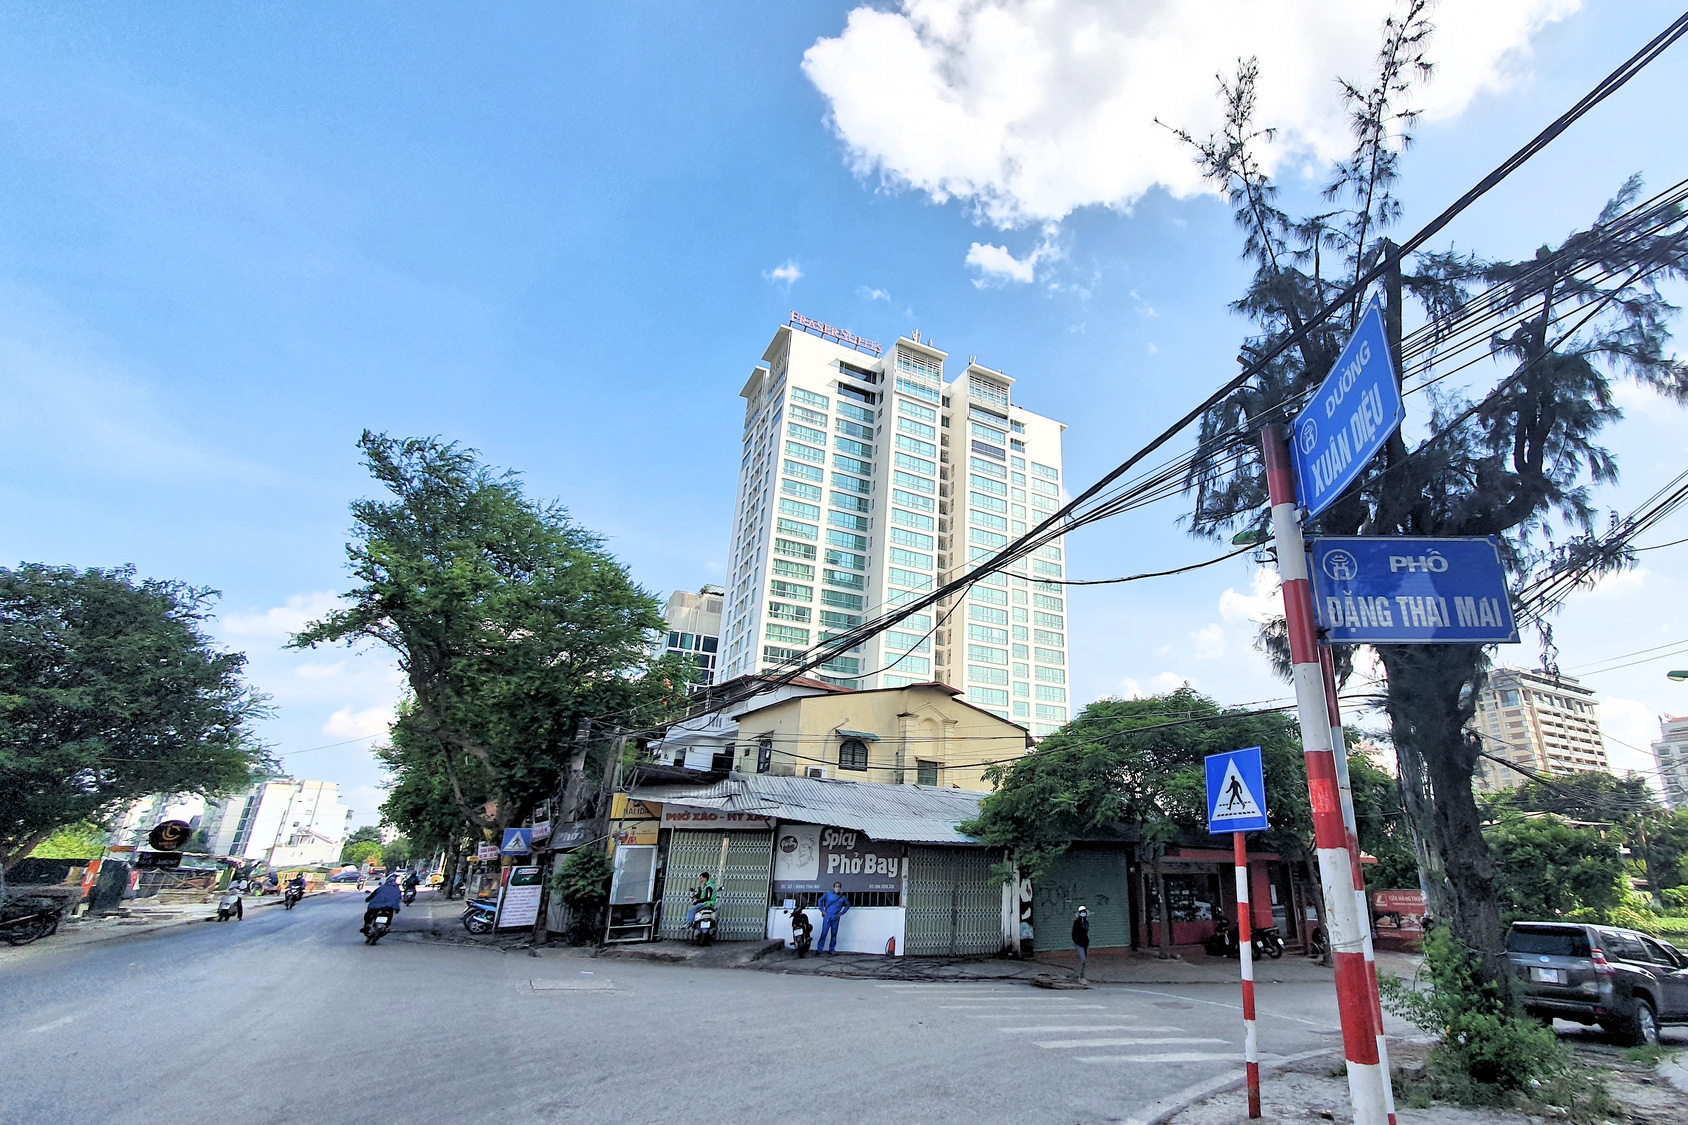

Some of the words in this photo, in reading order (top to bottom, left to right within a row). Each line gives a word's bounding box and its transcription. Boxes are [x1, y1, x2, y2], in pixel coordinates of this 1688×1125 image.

[790, 310, 840, 337] FRASER
[1325, 340, 1370, 419] ĐƯỜNG
[1311, 426, 1352, 497] XUÂN
[1350, 382, 1384, 453] DIỆU
[1389, 548, 1449, 573] PHỐ
[1326, 589, 1393, 633] ĐẶNG
[1395, 596, 1451, 628] THAI
[1453, 596, 1503, 627] MAI
[666, 811, 691, 821] PHỞ
[692, 811, 718, 821] XÀO
[822, 829, 858, 850] Spicy
[827, 852, 863, 875] Phở
[864, 853, 899, 879] Bay
